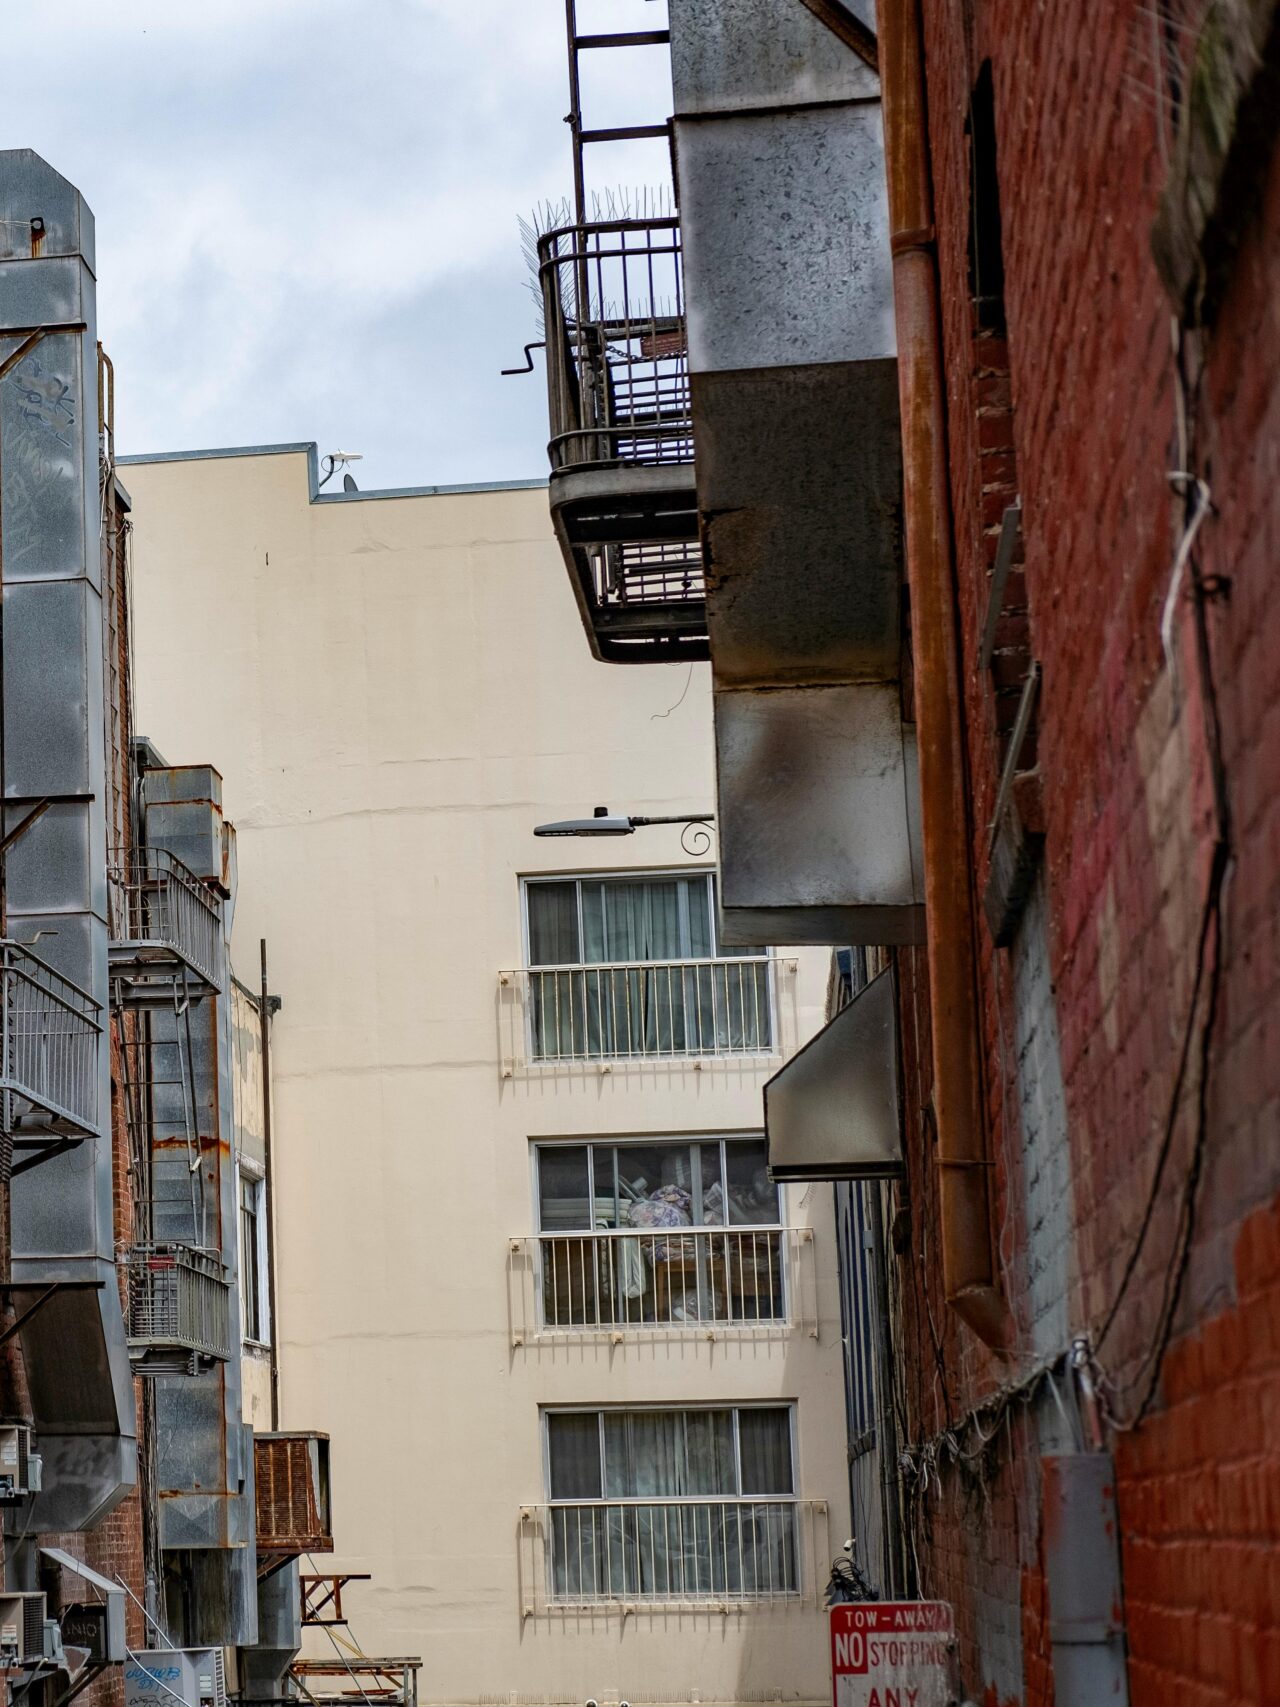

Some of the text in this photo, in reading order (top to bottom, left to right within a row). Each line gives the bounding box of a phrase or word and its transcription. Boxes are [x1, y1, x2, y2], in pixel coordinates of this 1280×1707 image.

[835, 1632, 948, 1668] NO STOPPING
[868, 1687, 918, 1707] ANY
